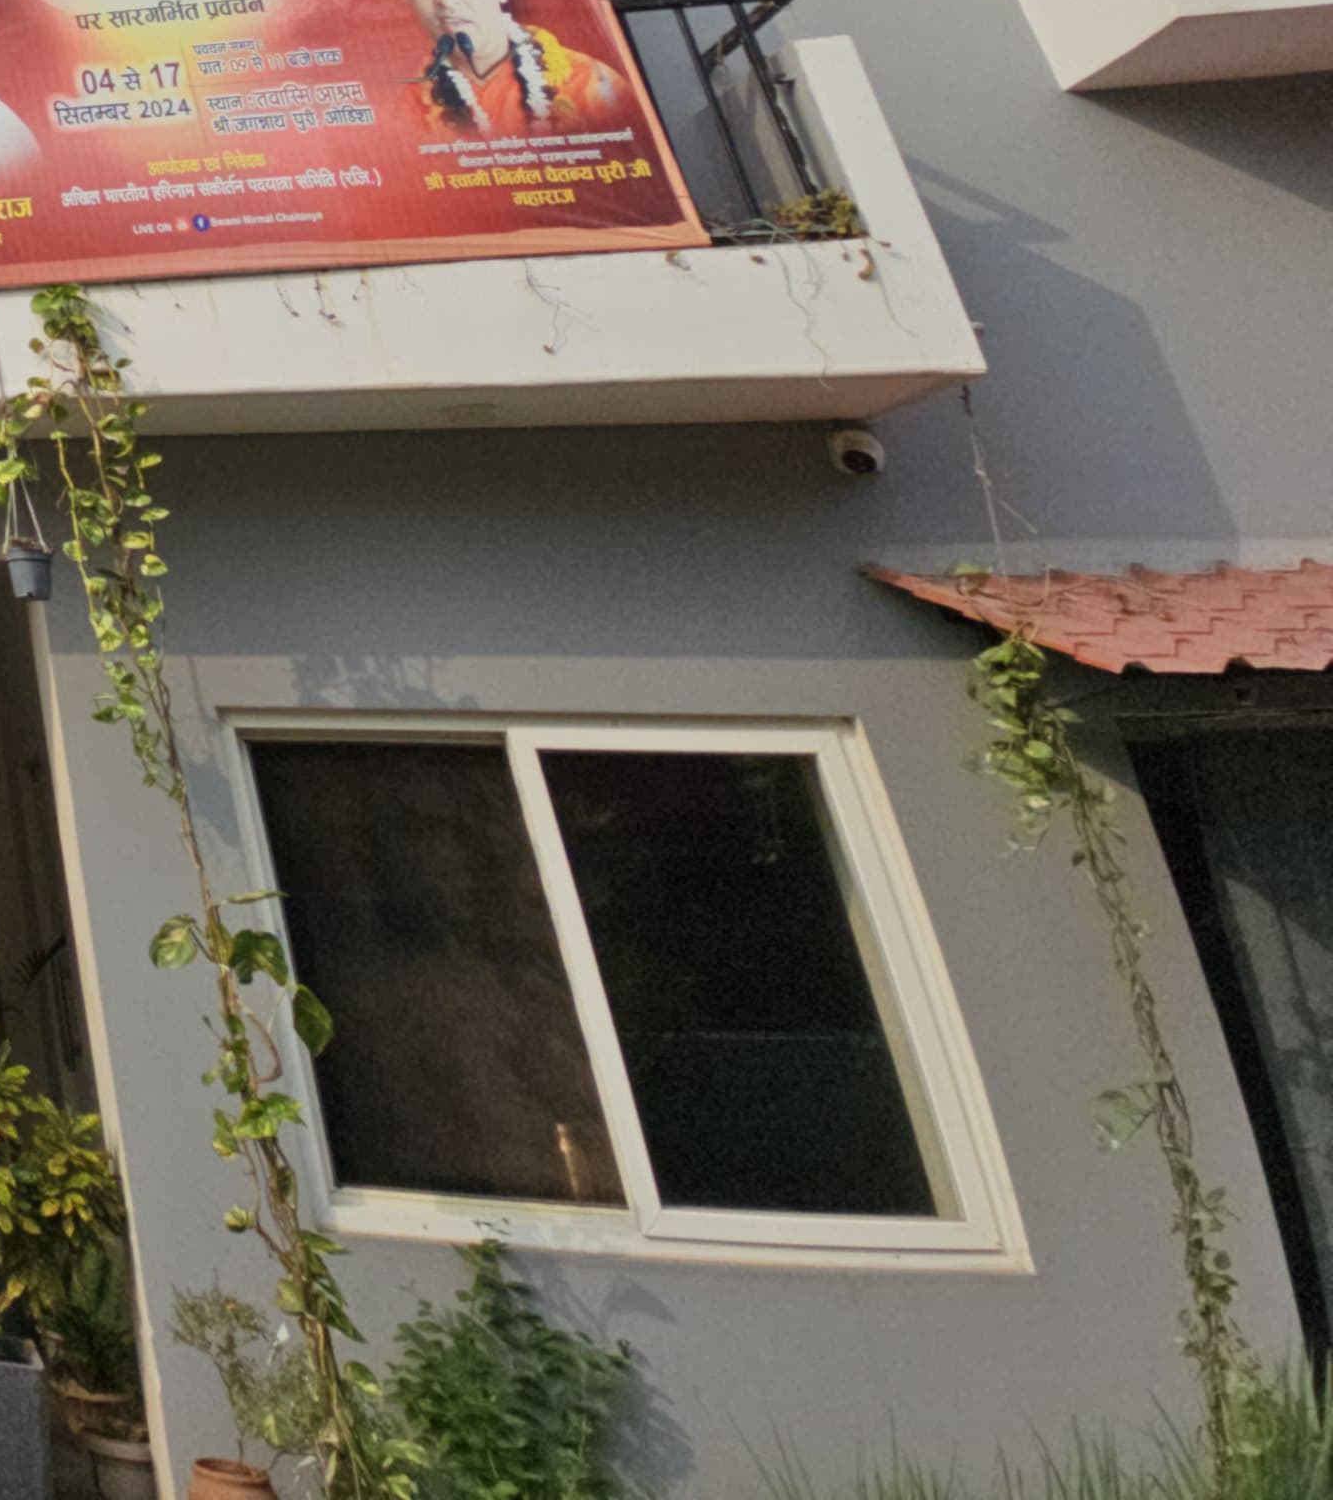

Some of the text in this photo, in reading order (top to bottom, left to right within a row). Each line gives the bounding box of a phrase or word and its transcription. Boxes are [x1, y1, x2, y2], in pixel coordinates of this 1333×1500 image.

[75, 11, 102, 31] पर
[230, 58, 247, 72] 09
[250, 53, 263, 70] से
[287, 48, 312, 66] बजे
[314, 49, 342, 64] तक
[81, 62, 180, 94] 04 से 17
[53, 98, 192, 125] सितम्बर 2024
[213, 116, 230, 134] श्री
[424, 171, 445, 191] श्री
[447, 168, 491, 189] स्वामी
[493, 166, 543, 186] निर्मल
[596, 159, 626, 184] पुरी
[628, 158, 653, 179] जी
[61, 185, 101, 208] अखिल
[103, 181, 150, 203] भारतीय
[152, 179, 195, 201] हरिनाम
[296, 168, 337, 188] समिति
[511, 188, 576, 207] महाराज
[133, 222, 155, 235] LIVE
[156, 221, 173, 234] ON
